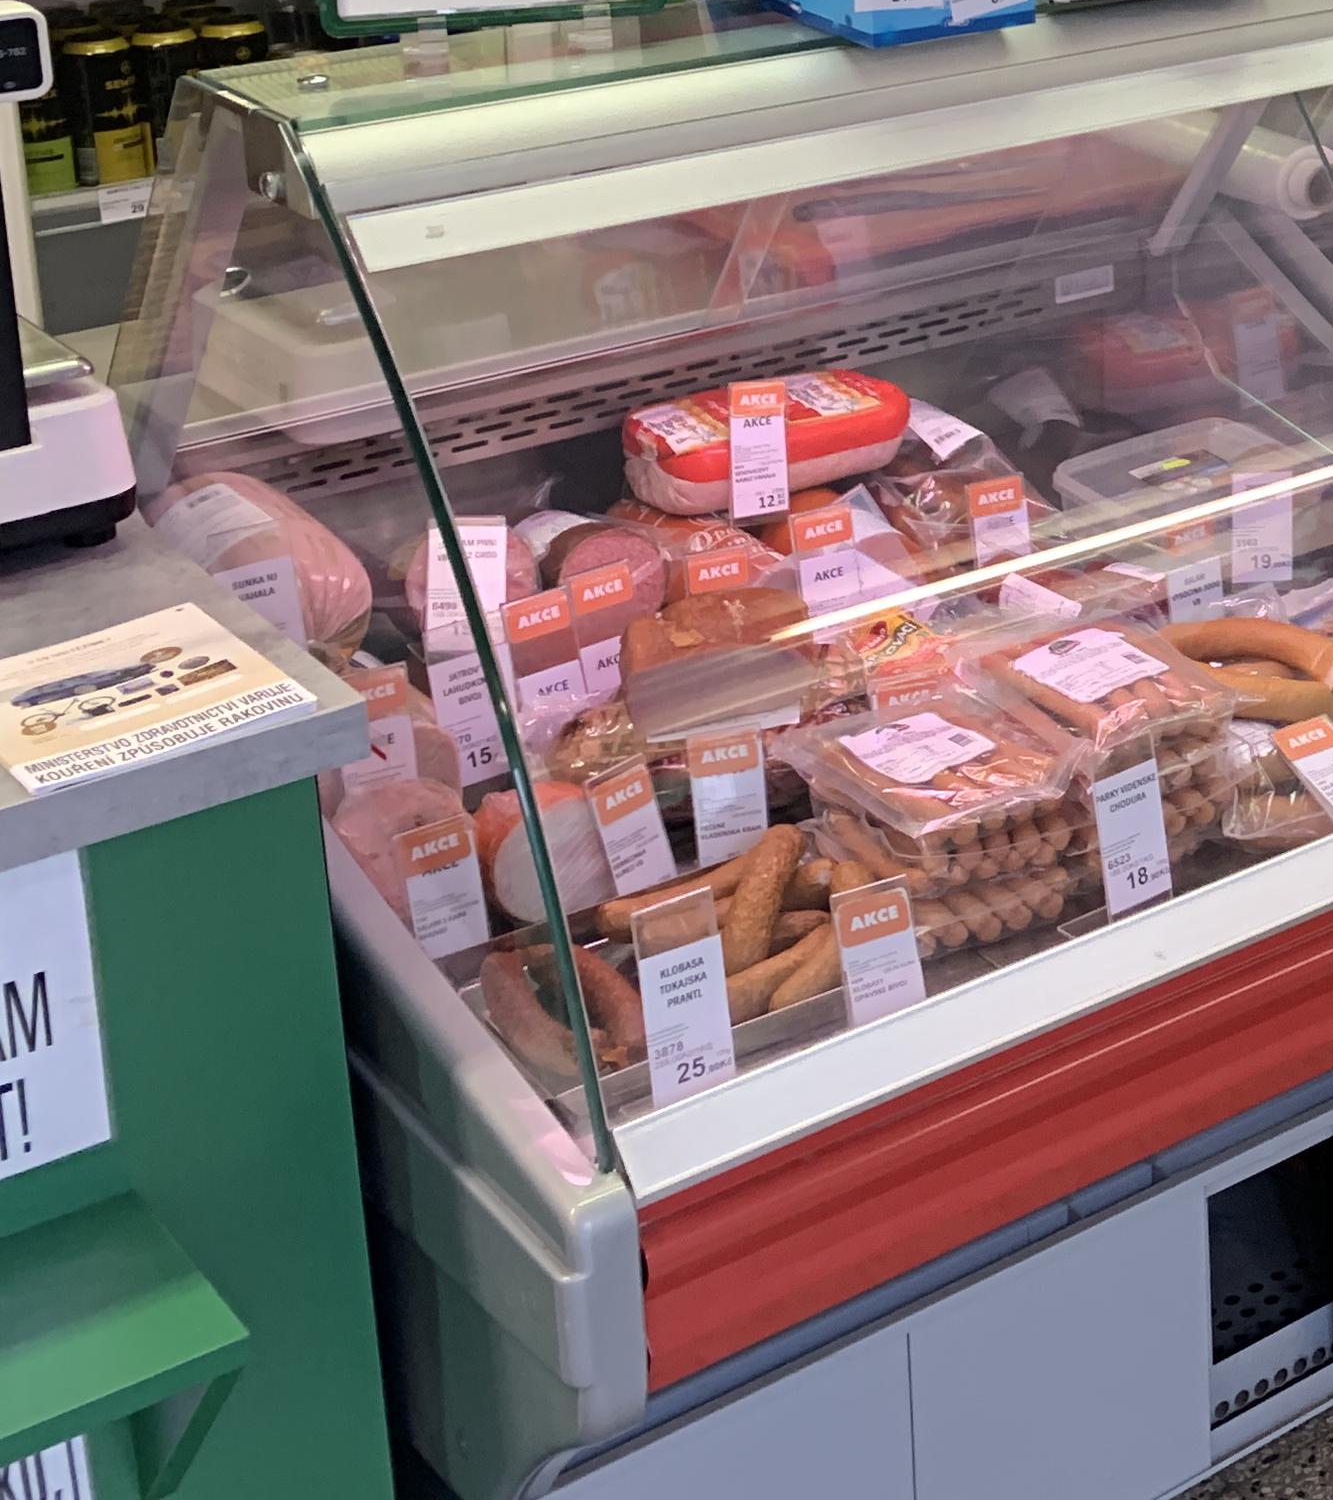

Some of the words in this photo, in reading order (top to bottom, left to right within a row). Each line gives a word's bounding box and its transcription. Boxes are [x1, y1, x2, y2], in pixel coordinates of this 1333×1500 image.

[221, 692, 304, 729] RAKOVINU
[24, 736, 131, 775] MINISTERSTVO
[1109, 791, 1147, 813] CHODURA
[660, 956, 705, 979] KLOBASA
[666, 989, 704, 1008] PRANTL
